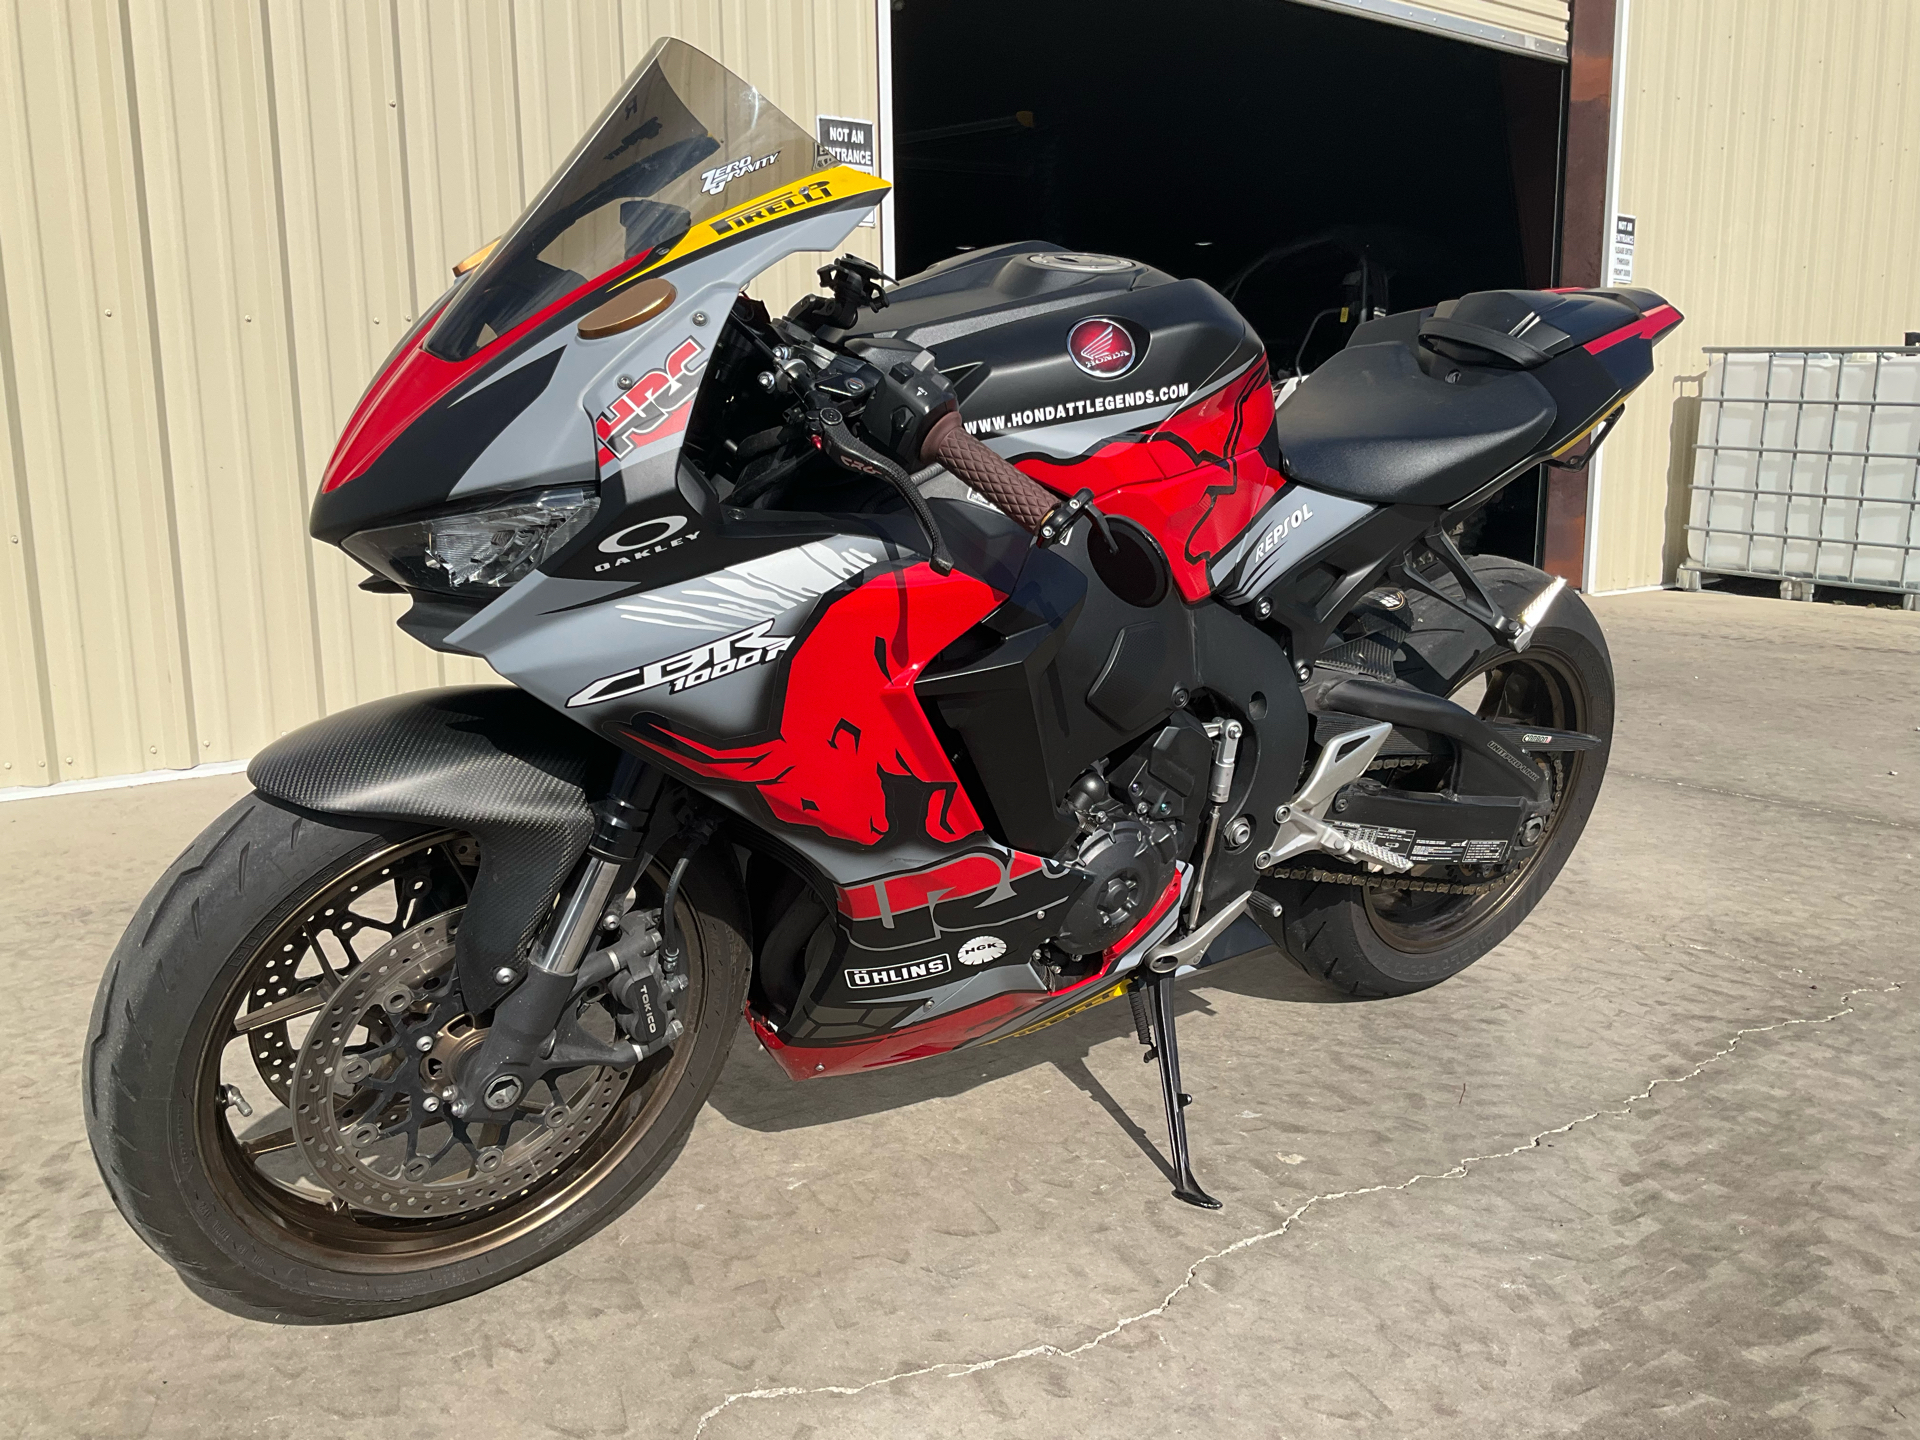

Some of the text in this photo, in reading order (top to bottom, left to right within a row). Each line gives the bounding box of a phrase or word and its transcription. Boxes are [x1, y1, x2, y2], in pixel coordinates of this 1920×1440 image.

[829, 126, 864, 144] NOT AN
[701, 156, 752, 193] ZERO
[709, 151, 781, 195] GRAVITY
[709, 181, 832, 236] PIRELLI
[1085, 350, 1130, 368] HONDA
[596, 336, 707, 460] HRC
[964, 383, 1189, 435] WWW.HONDATTLEGENDS.COM
[594, 531, 700, 573] OAKLEY
[1255, 503, 1314, 563] REPSOL
[566, 618, 796, 708] CBR
[965, 943, 998, 955] NGK
[854, 960, 944, 985] ÖHLINS
[640, 984, 657, 1034] TOKICO
